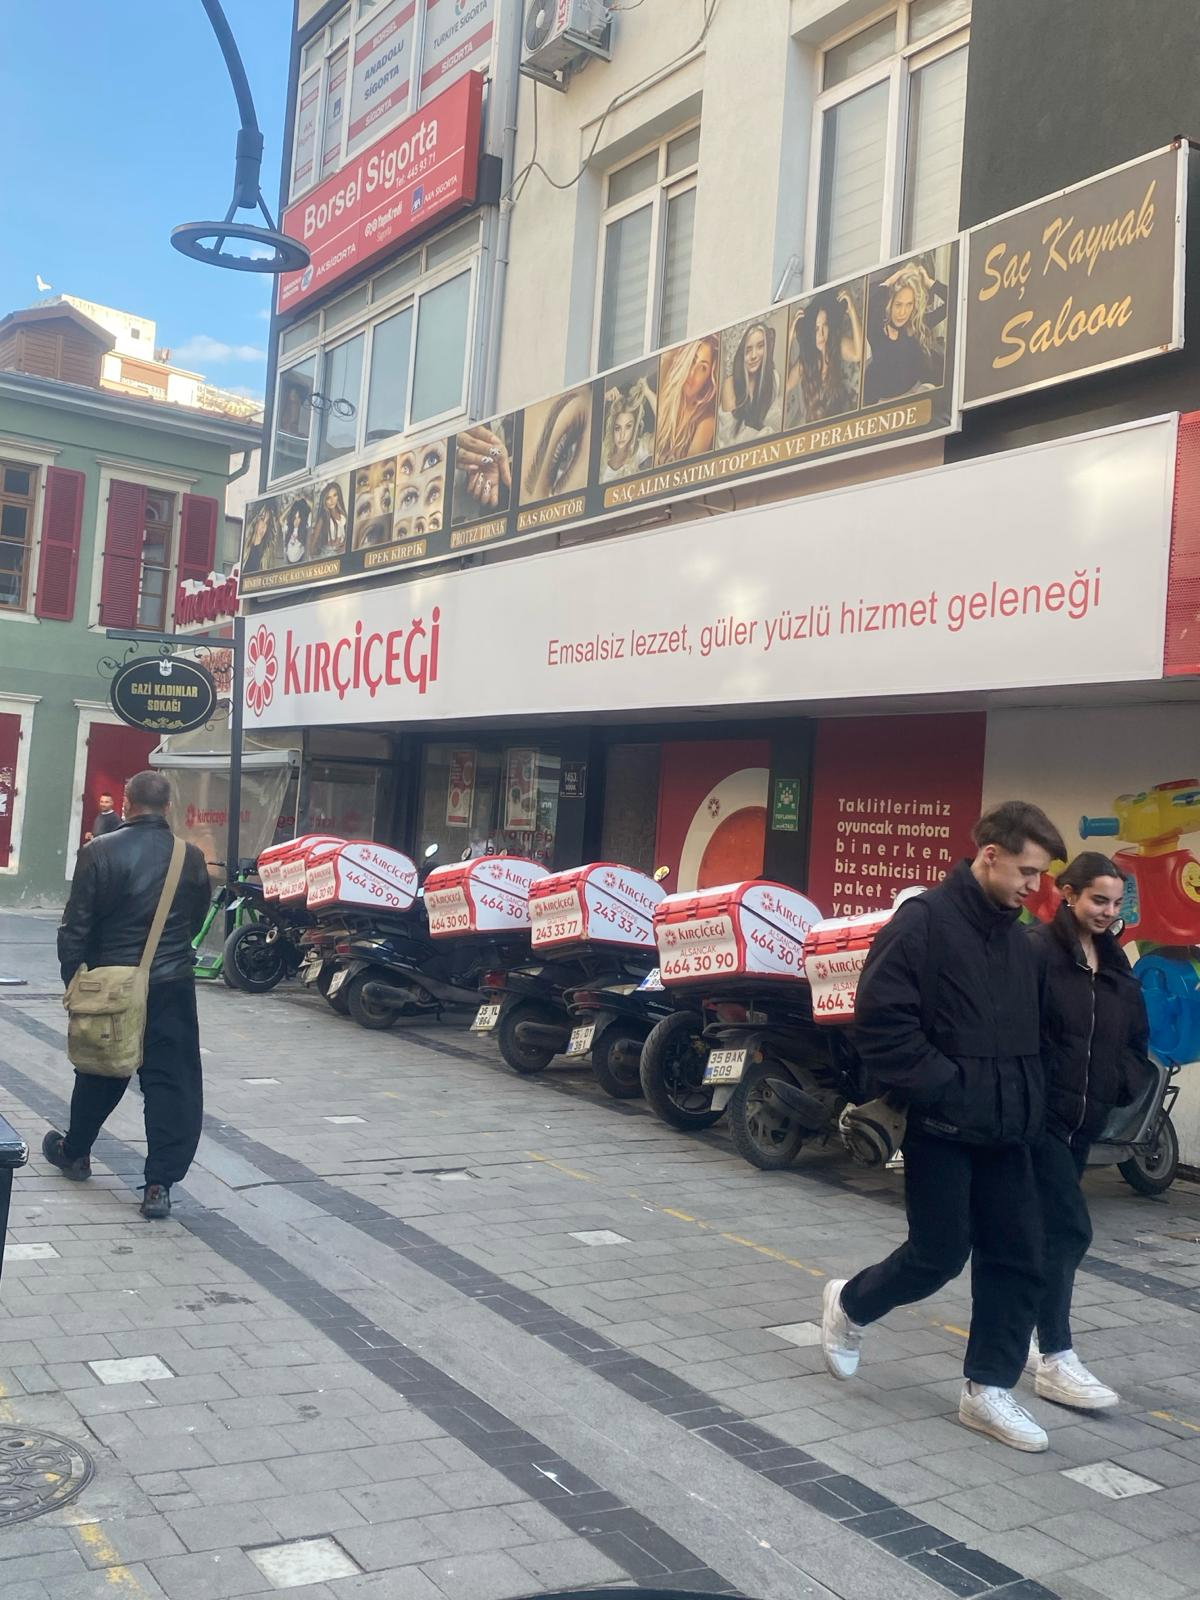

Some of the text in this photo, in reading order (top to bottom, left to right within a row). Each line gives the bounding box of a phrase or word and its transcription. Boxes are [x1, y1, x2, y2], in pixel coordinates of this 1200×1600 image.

[364, 40, 404, 80] ANADOLU
[364, 65, 400, 100] SİGORTA
[303, 118, 438, 240] Borsel Sigorta
[978, 179, 1157, 301] Saç Kaynak
[991, 295, 1133, 369] Saloon
[612, 406, 917, 503] SAÇ ALIM SATIM TOPTAN VE PERAKENDE
[519, 498, 584, 528] KAŞ KONTÖR
[452, 528, 477, 546] PROTEZ
[548, 567, 1101, 666] Emsalsiz lezzet, güler yüzlü hizmet geleneği
[131, 681, 198, 698] GAZİ KADINLAR
[147, 699, 181, 712] SOKAĞI
[838, 798, 951, 816] Taklitlerimiz
[837, 820, 950, 838] oyuncak motora
[835, 858, 946, 882] biz sahicisi ile
[346, 871, 400, 907] 464 30 90
[833, 880, 882, 898] paket
[480, 894, 504, 913] 464
[507, 904, 523, 919] 30
[431, 913, 468, 930] 464 30 90
[536, 920, 578, 940] 243 33 77
[593, 901, 649, 942] 243 33 77
[680, 944, 717, 957] ALSANCAK
[750, 928, 775, 955] 464
[777, 944, 794, 966] 30
[768, 929, 800, 954] ALSANCAK
[664, 952, 734, 975] 464 30 90
[479, 1006, 489, 1016] 35
[817, 991, 856, 1012] 464 3
[571, 1030, 580, 1040] 35
[710, 1051, 745, 1064] 35 BAK
[712, 1065, 733, 1077] 509
